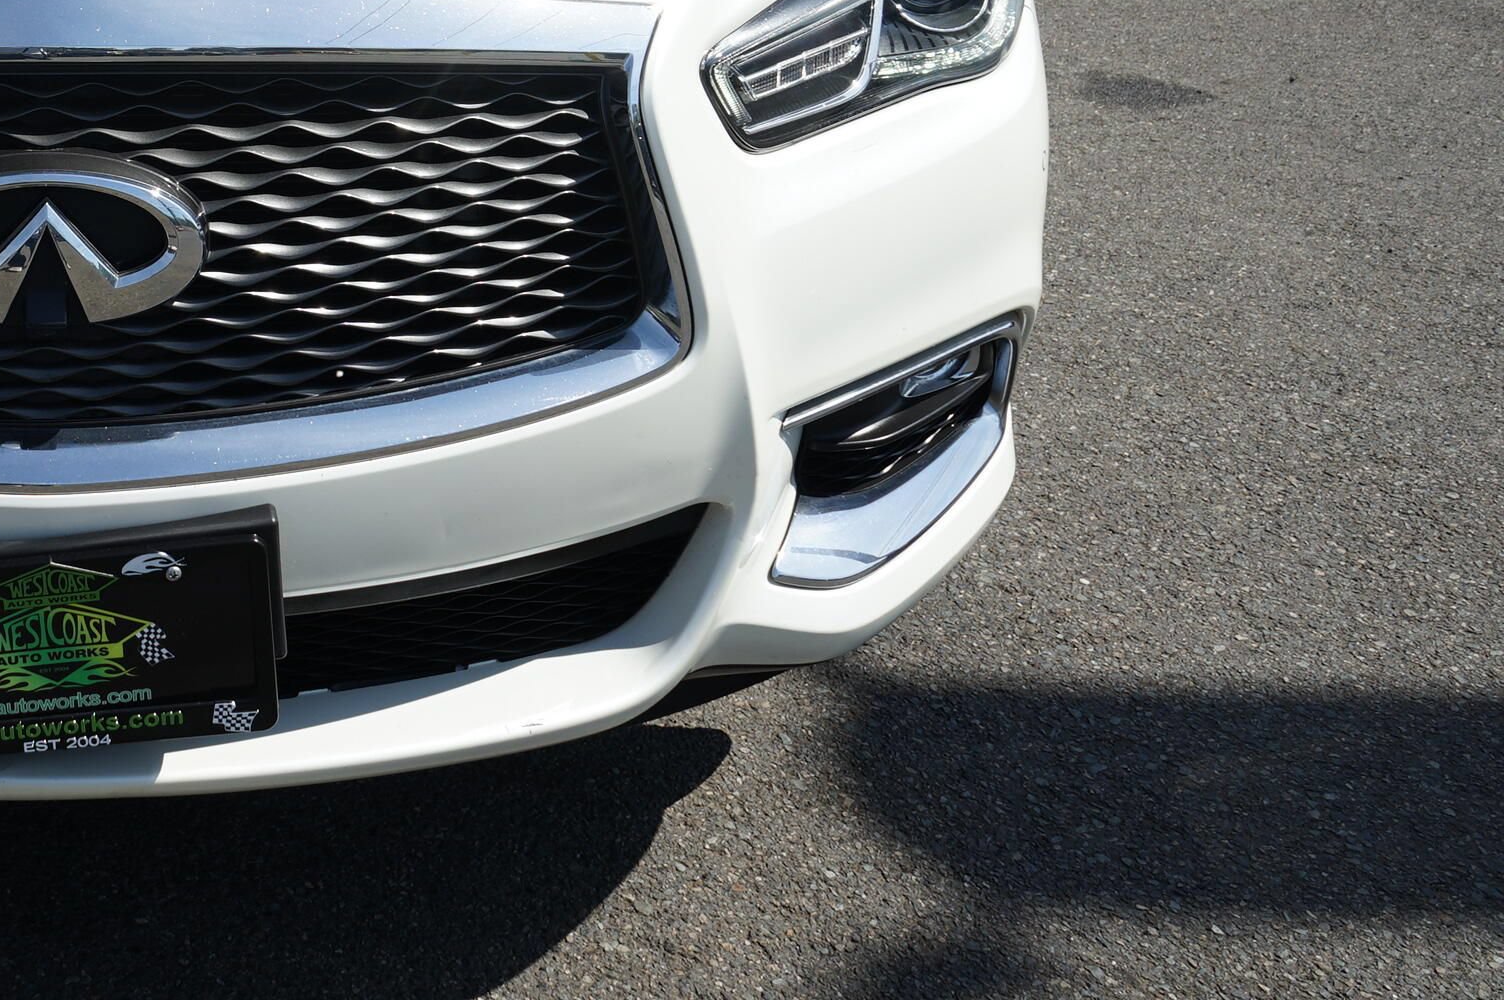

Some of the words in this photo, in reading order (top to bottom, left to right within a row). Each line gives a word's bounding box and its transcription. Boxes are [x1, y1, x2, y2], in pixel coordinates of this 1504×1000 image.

[7, 599, 43, 609] AUTO
[48, 592, 97, 605] WORKS
[47, 647, 109, 663] WORKS
[23, 738, 61, 753] EST
[66, 733, 112, 750] 2004
